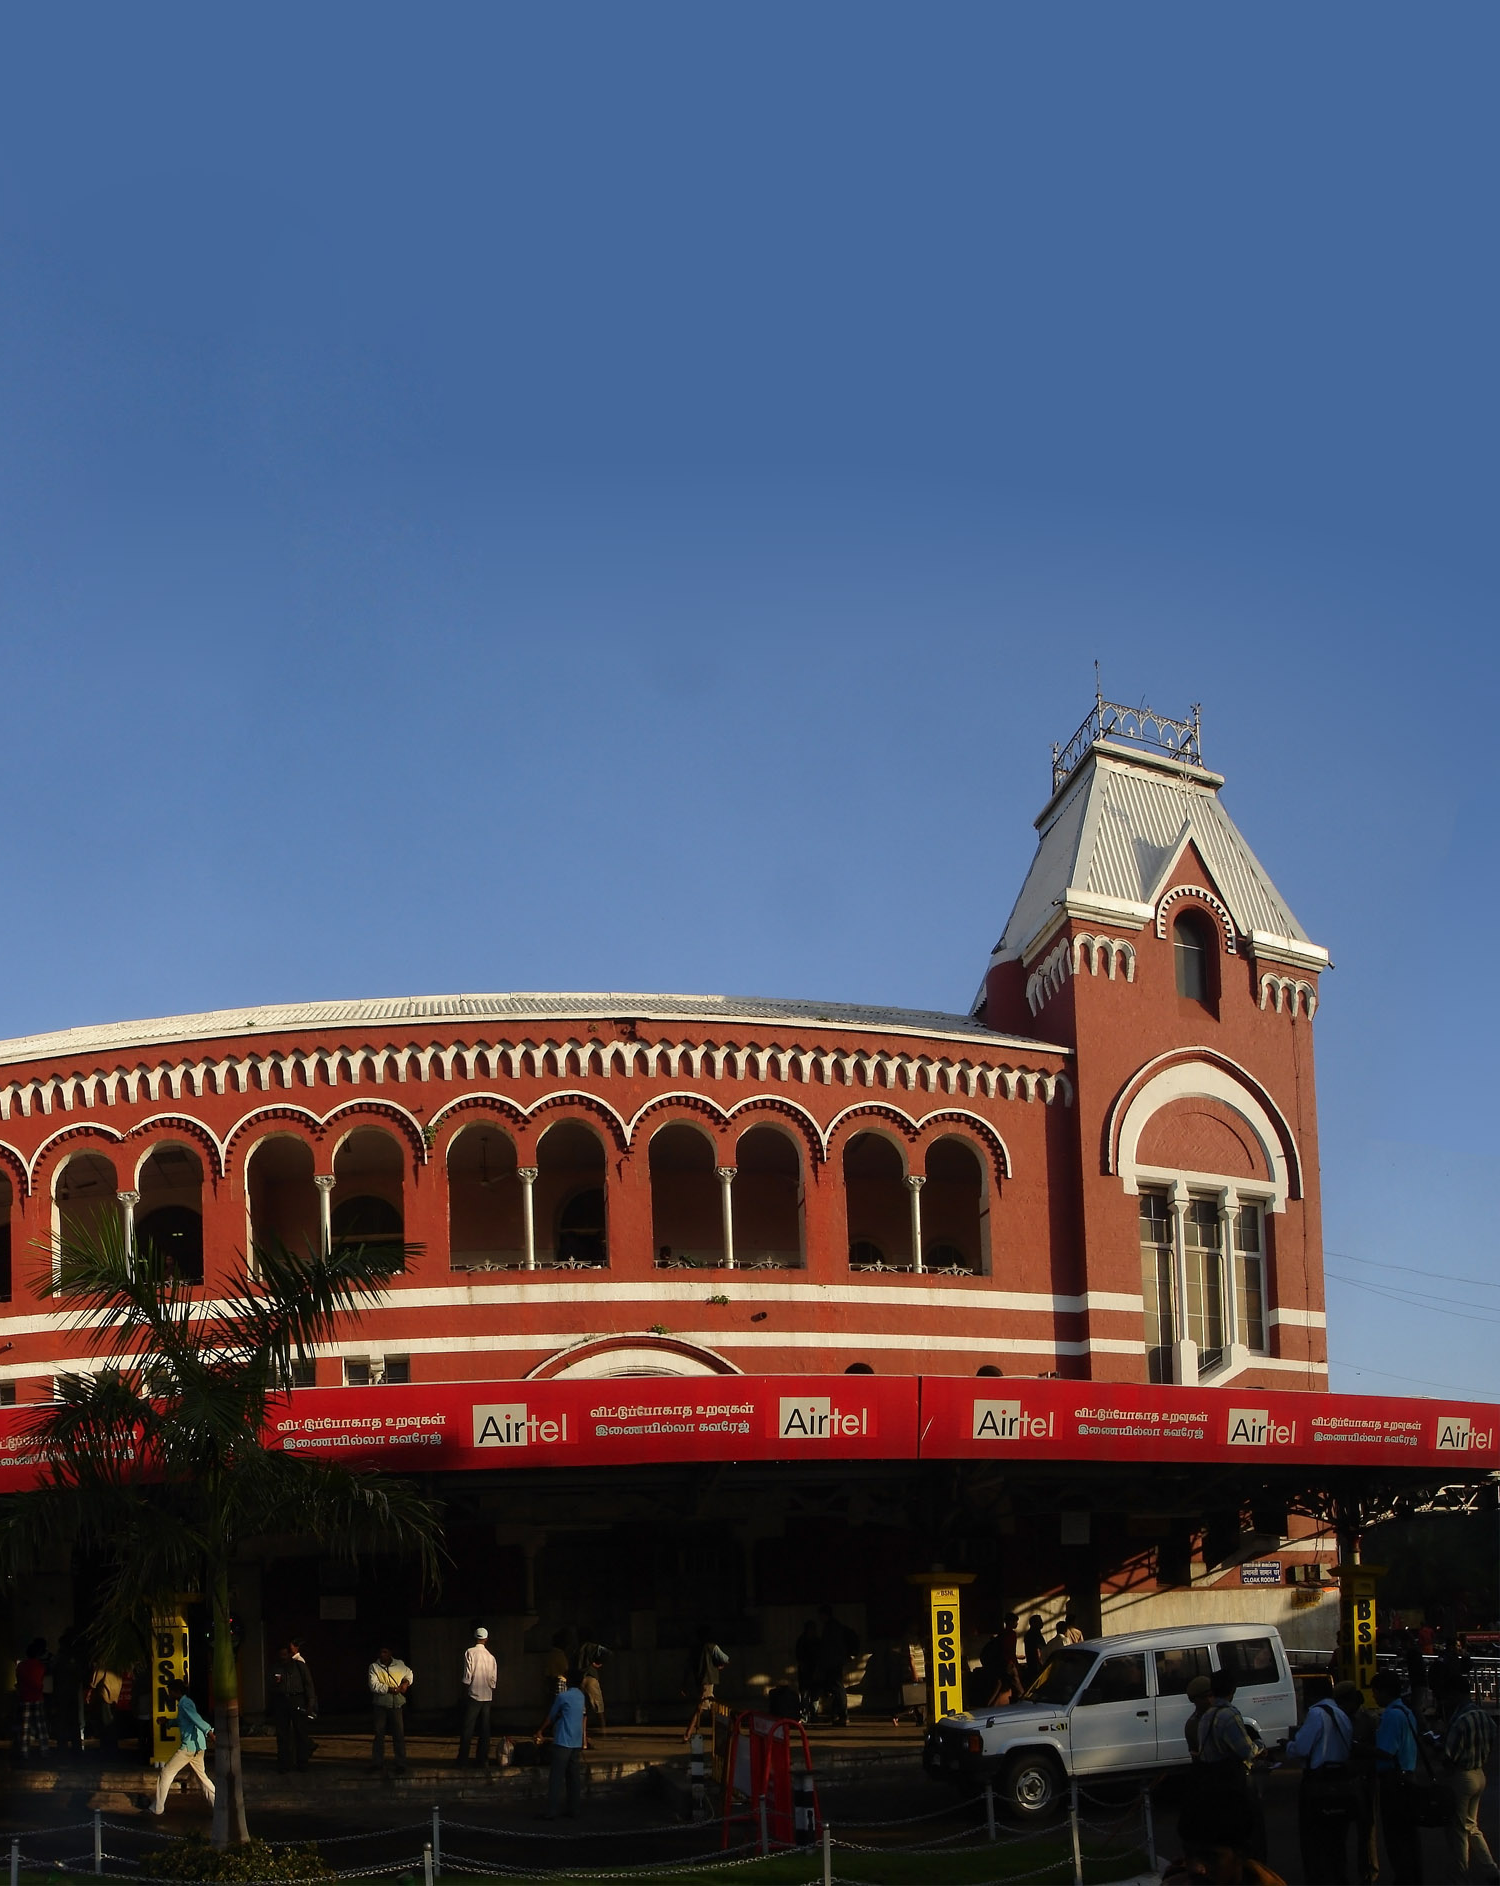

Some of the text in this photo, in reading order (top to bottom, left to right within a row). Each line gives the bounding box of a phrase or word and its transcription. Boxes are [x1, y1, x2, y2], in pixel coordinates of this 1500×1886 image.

[695, 1401, 754, 1417] உறவுகள்
[1161, 1411, 1208, 1424] உறவுகள்
[385, 1412, 446, 1429] உறவுகள்
[478, 1412, 567, 1444] Airtel
[595, 1419, 750, 1437] இணையில்லா கவரேஜ்
[783, 1407, 867, 1436] Airtel
[977, 1409, 1054, 1437] Airtel
[1231, 1417, 1296, 1444] Airtel
[1383, 1420, 1422, 1433] உறவுகள்
[283, 1431, 442, 1450] இணையில்லா கவரேஜ்
[1078, 1424, 1204, 1440] இணையில்லா கவரேஜ்
[1313, 1432, 1418, 1447] இணையில்லா கவரேஜ்
[1440, 1425, 1492, 1449] Airtel
[1357, 1599, 1373, 1690] BSNL
[936, 1610, 956, 1717] BSNL
[157, 1632, 177, 1742] BSNL
